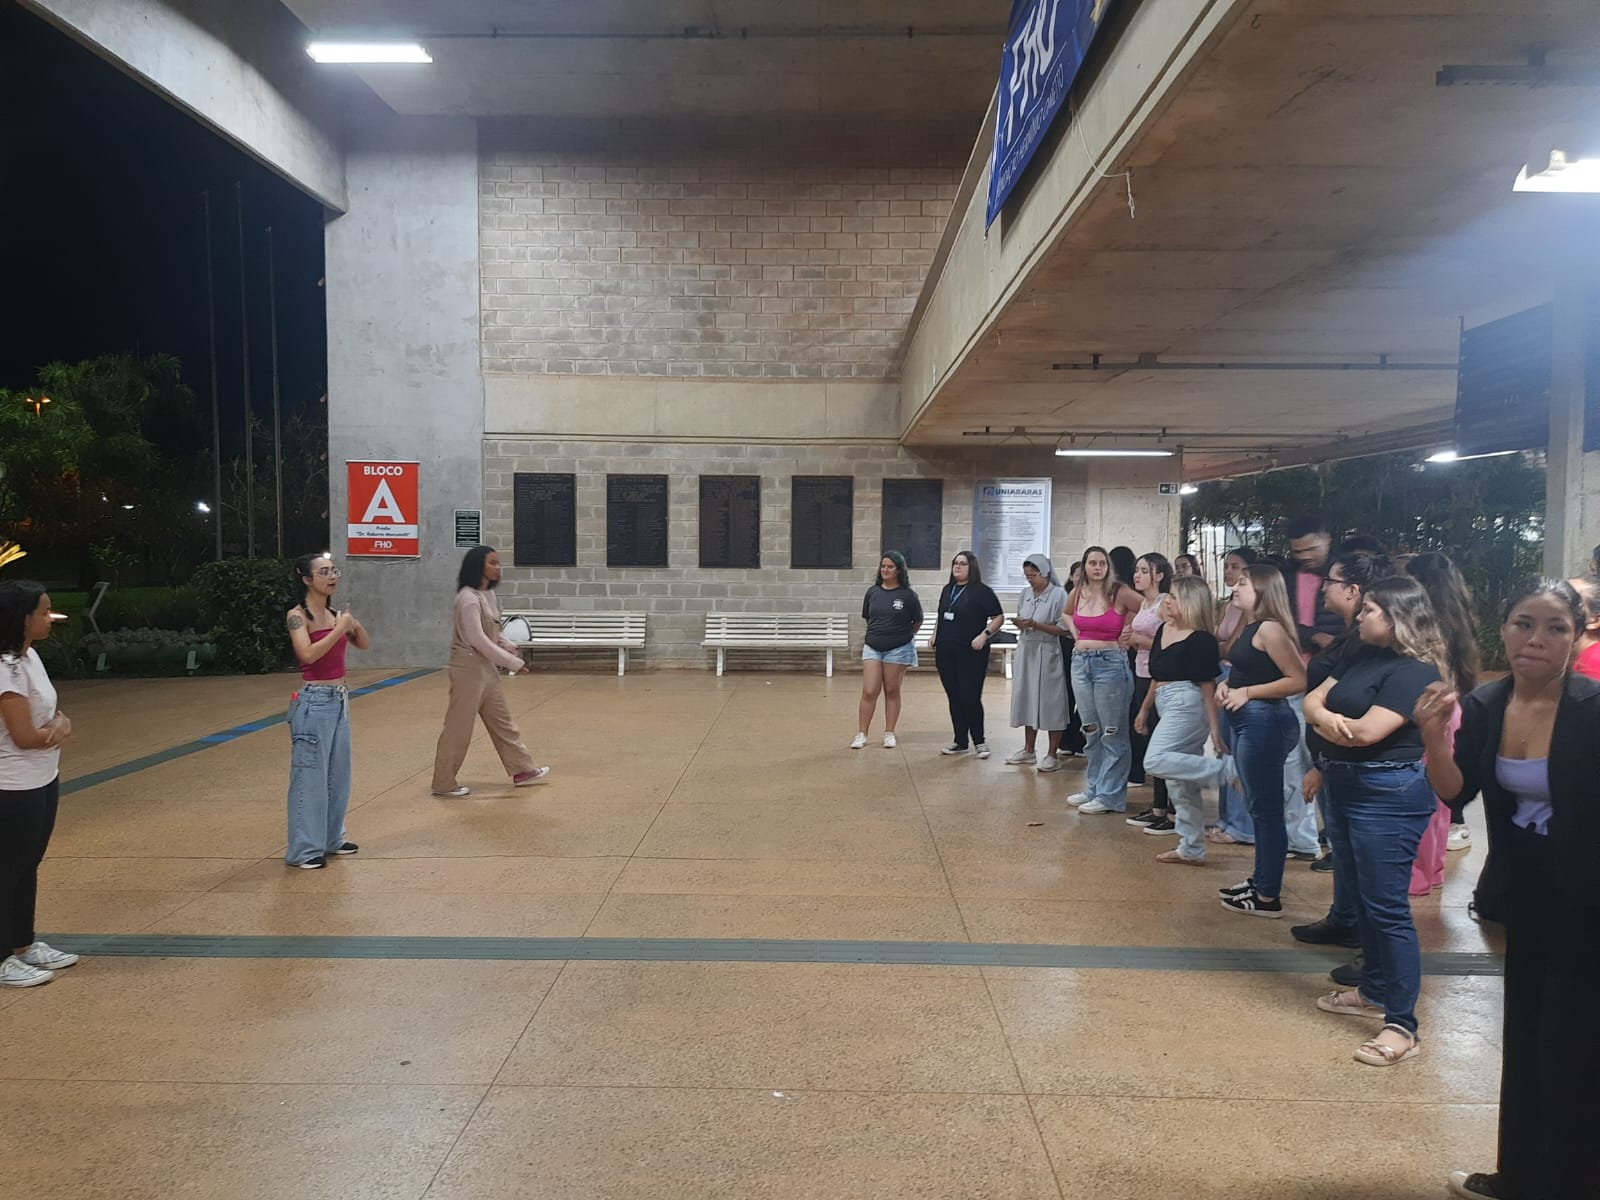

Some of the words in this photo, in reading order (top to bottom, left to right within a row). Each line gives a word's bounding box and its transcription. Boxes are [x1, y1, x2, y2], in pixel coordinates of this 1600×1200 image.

[363, 466, 403, 476] BLOCO
[361, 478, 406, 522] A
[374, 540, 393, 549] FHO
